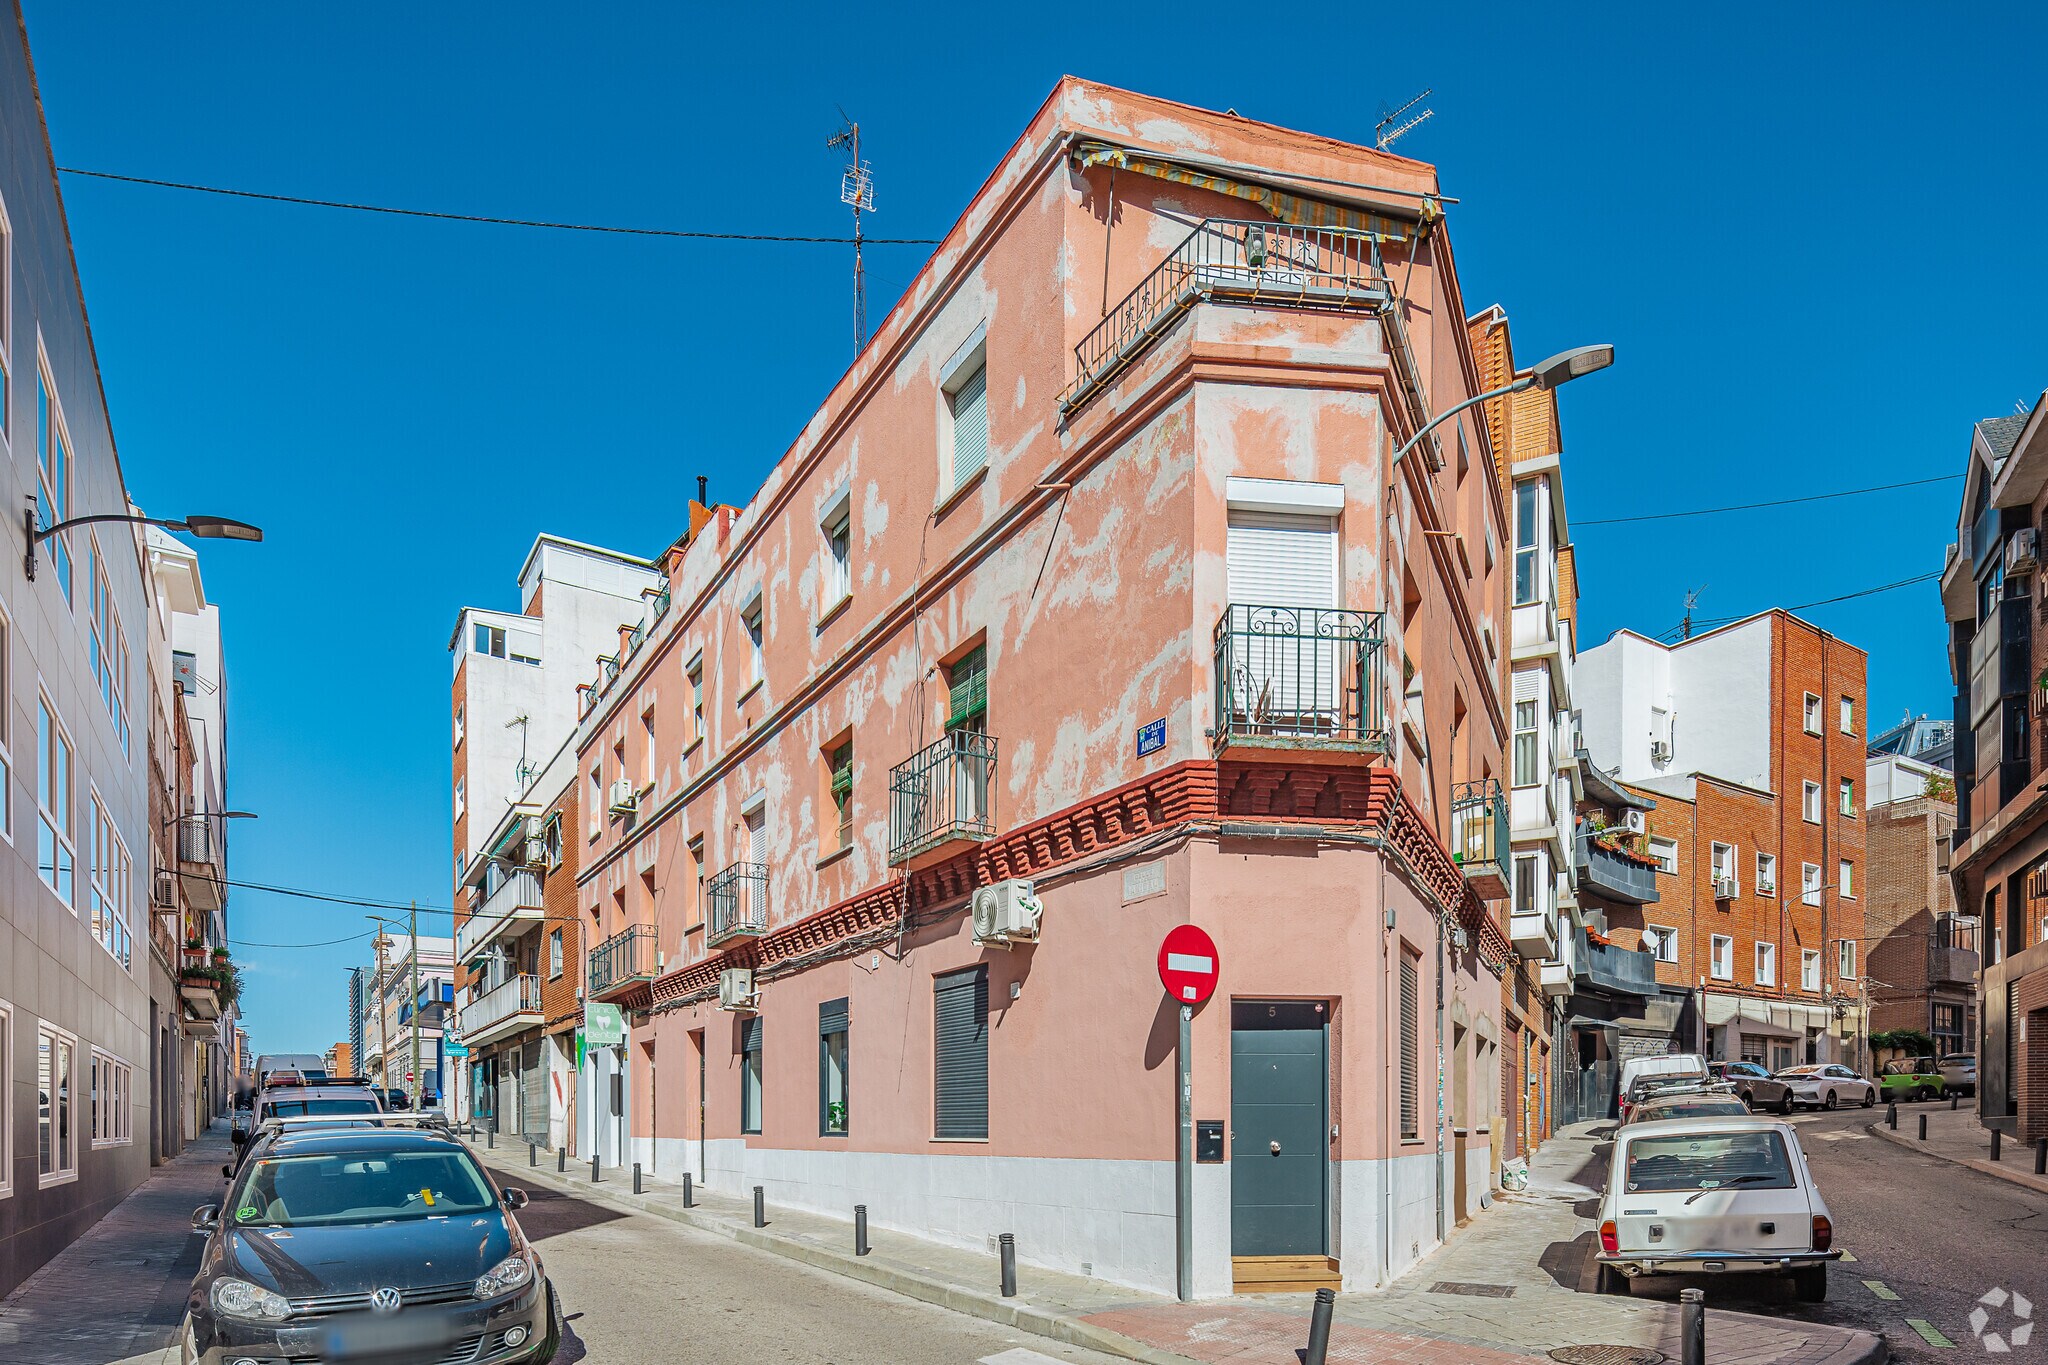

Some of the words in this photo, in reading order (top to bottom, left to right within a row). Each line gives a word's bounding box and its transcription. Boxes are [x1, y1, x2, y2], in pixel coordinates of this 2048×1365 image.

[1146, 719, 1165, 733] CALLE
[1140, 735, 1161, 753] ANIBAL
[1268, 1006, 1276, 1017] 5
[588, 1029, 620, 1039] dental
